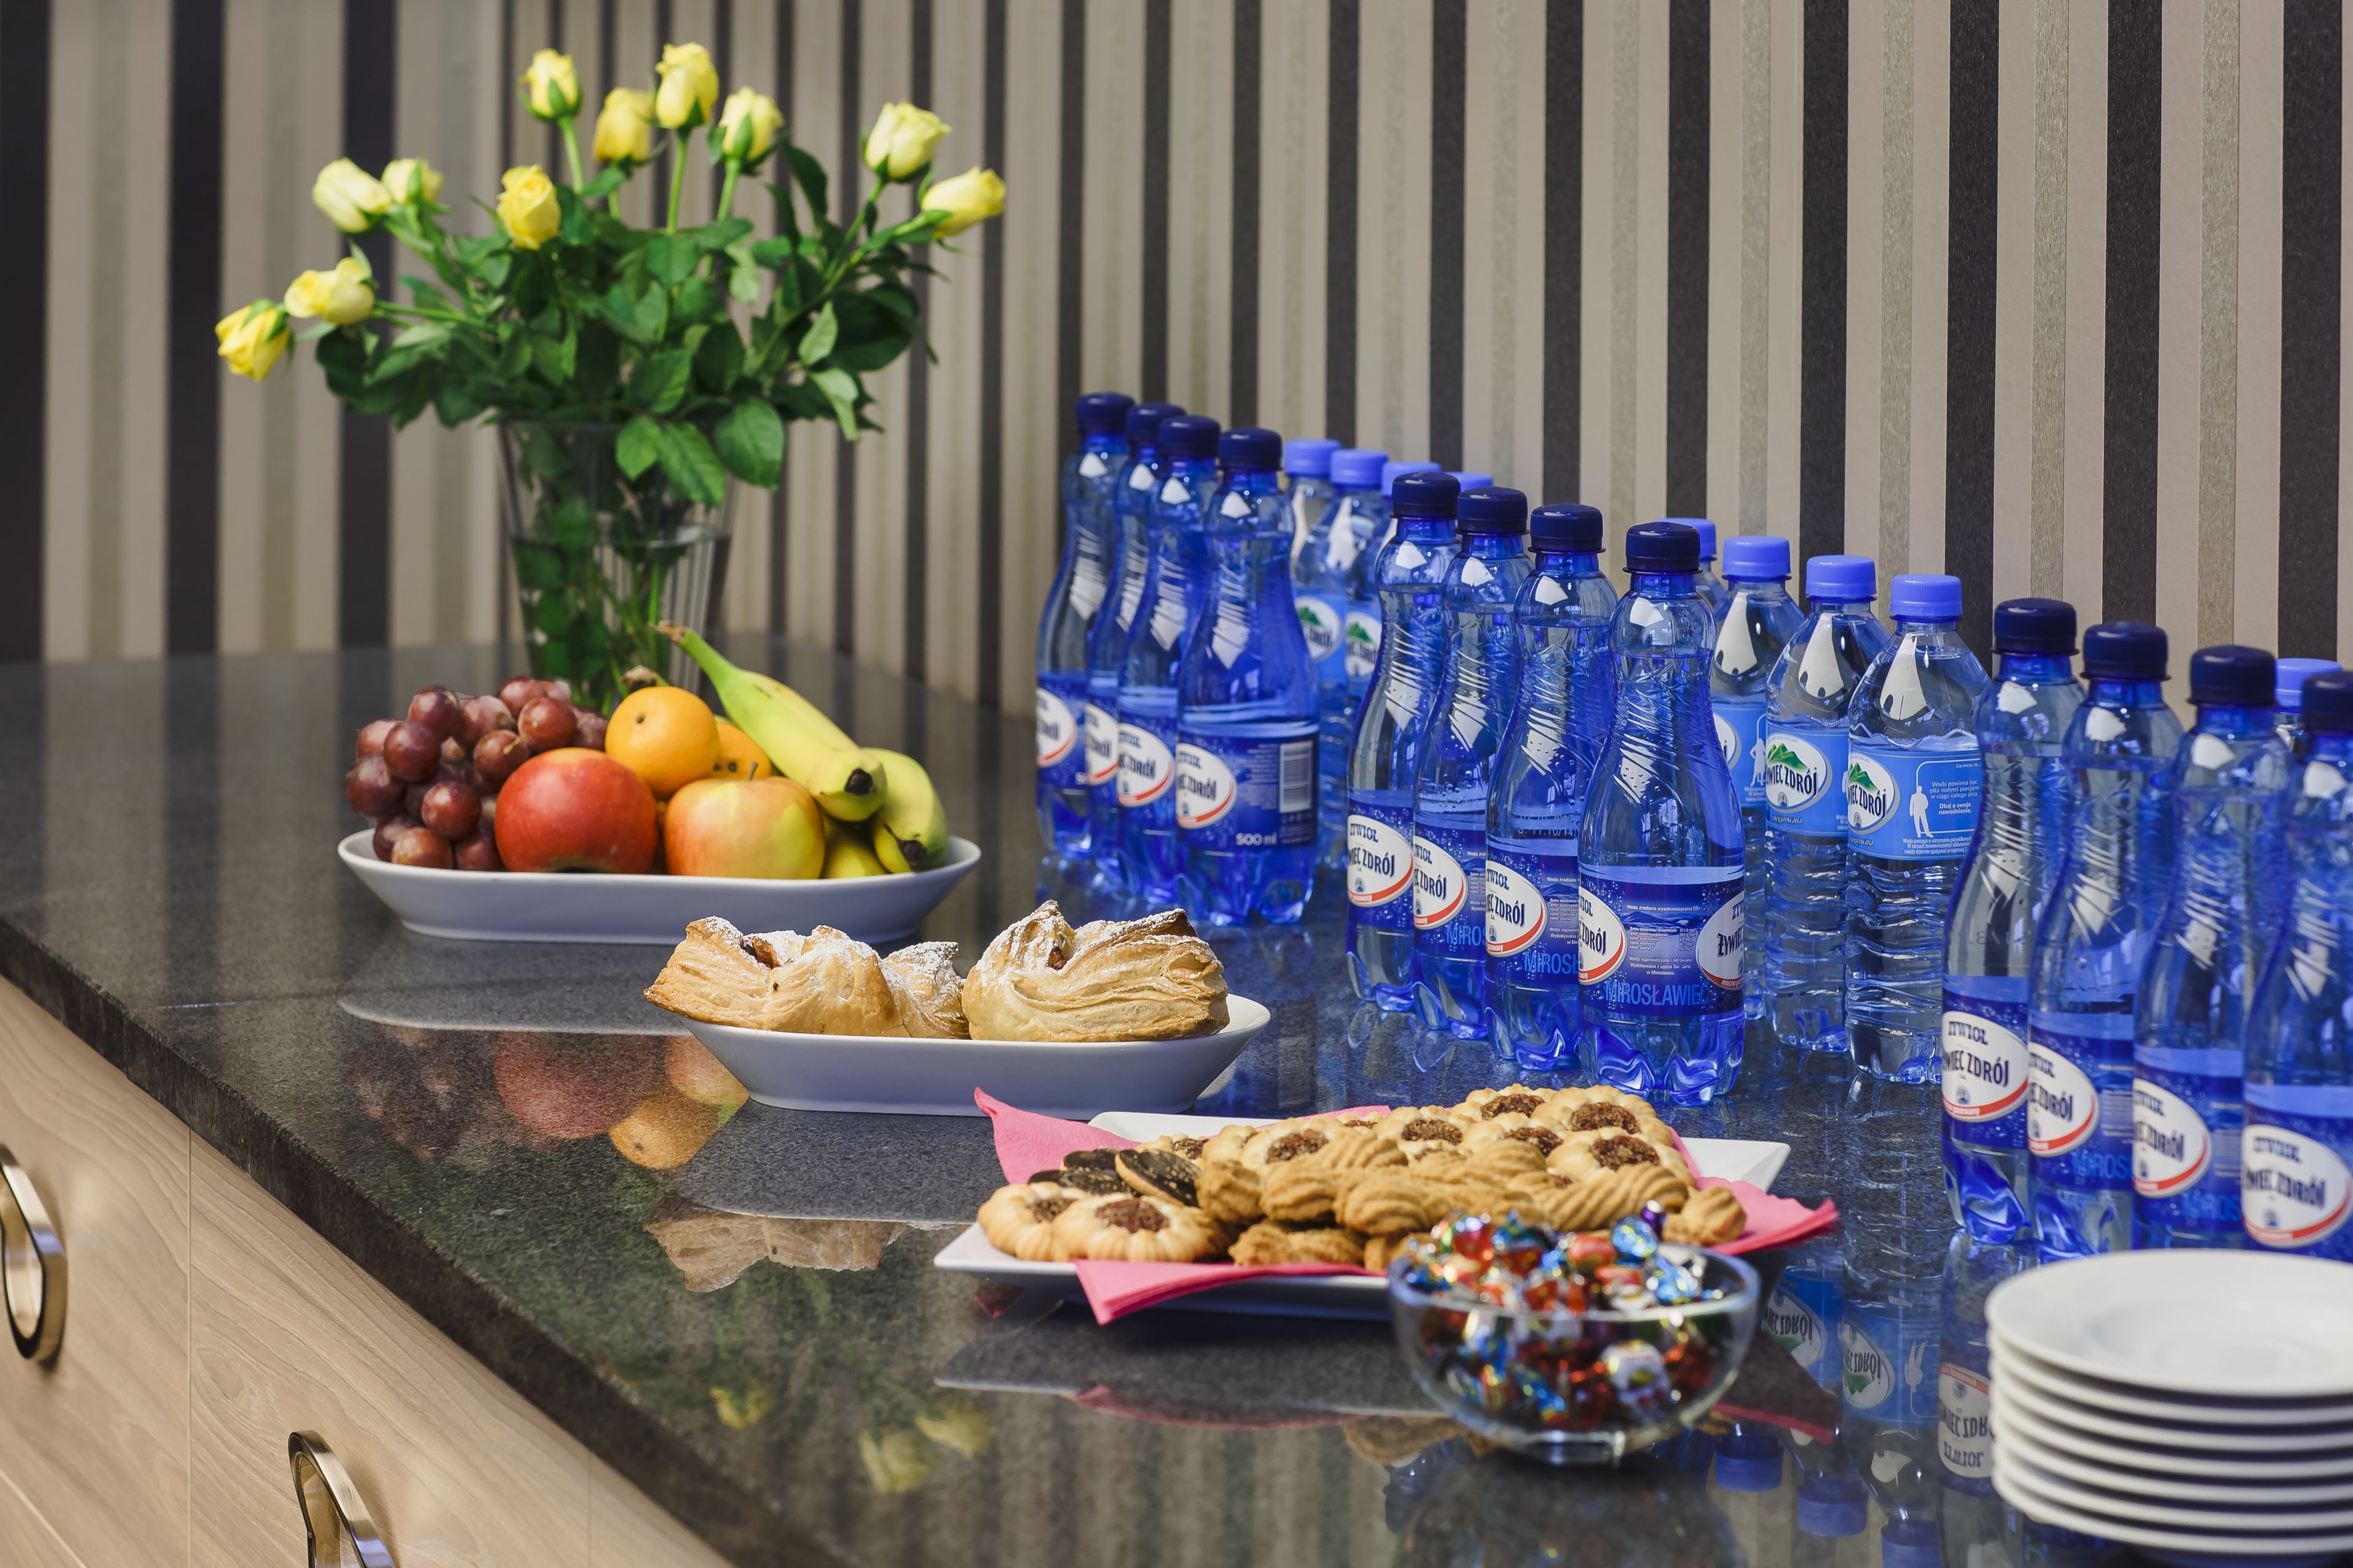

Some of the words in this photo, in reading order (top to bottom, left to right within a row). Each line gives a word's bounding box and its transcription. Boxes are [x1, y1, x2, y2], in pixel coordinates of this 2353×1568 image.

[1235, 833, 1262, 845] 500
[1264, 831, 1277, 844] ml
[1362, 849, 1395, 877] ZDRÓJ
[1420, 869, 1447, 900] ZDRÓJ
[1495, 895, 1525, 927] ZDRÓJ
[1582, 923, 1607, 955] ZDRÓJ
[1605, 979, 1710, 1006] MIROSŁAWIEC
[1967, 1052, 2009, 1088] ZDRÓJ
